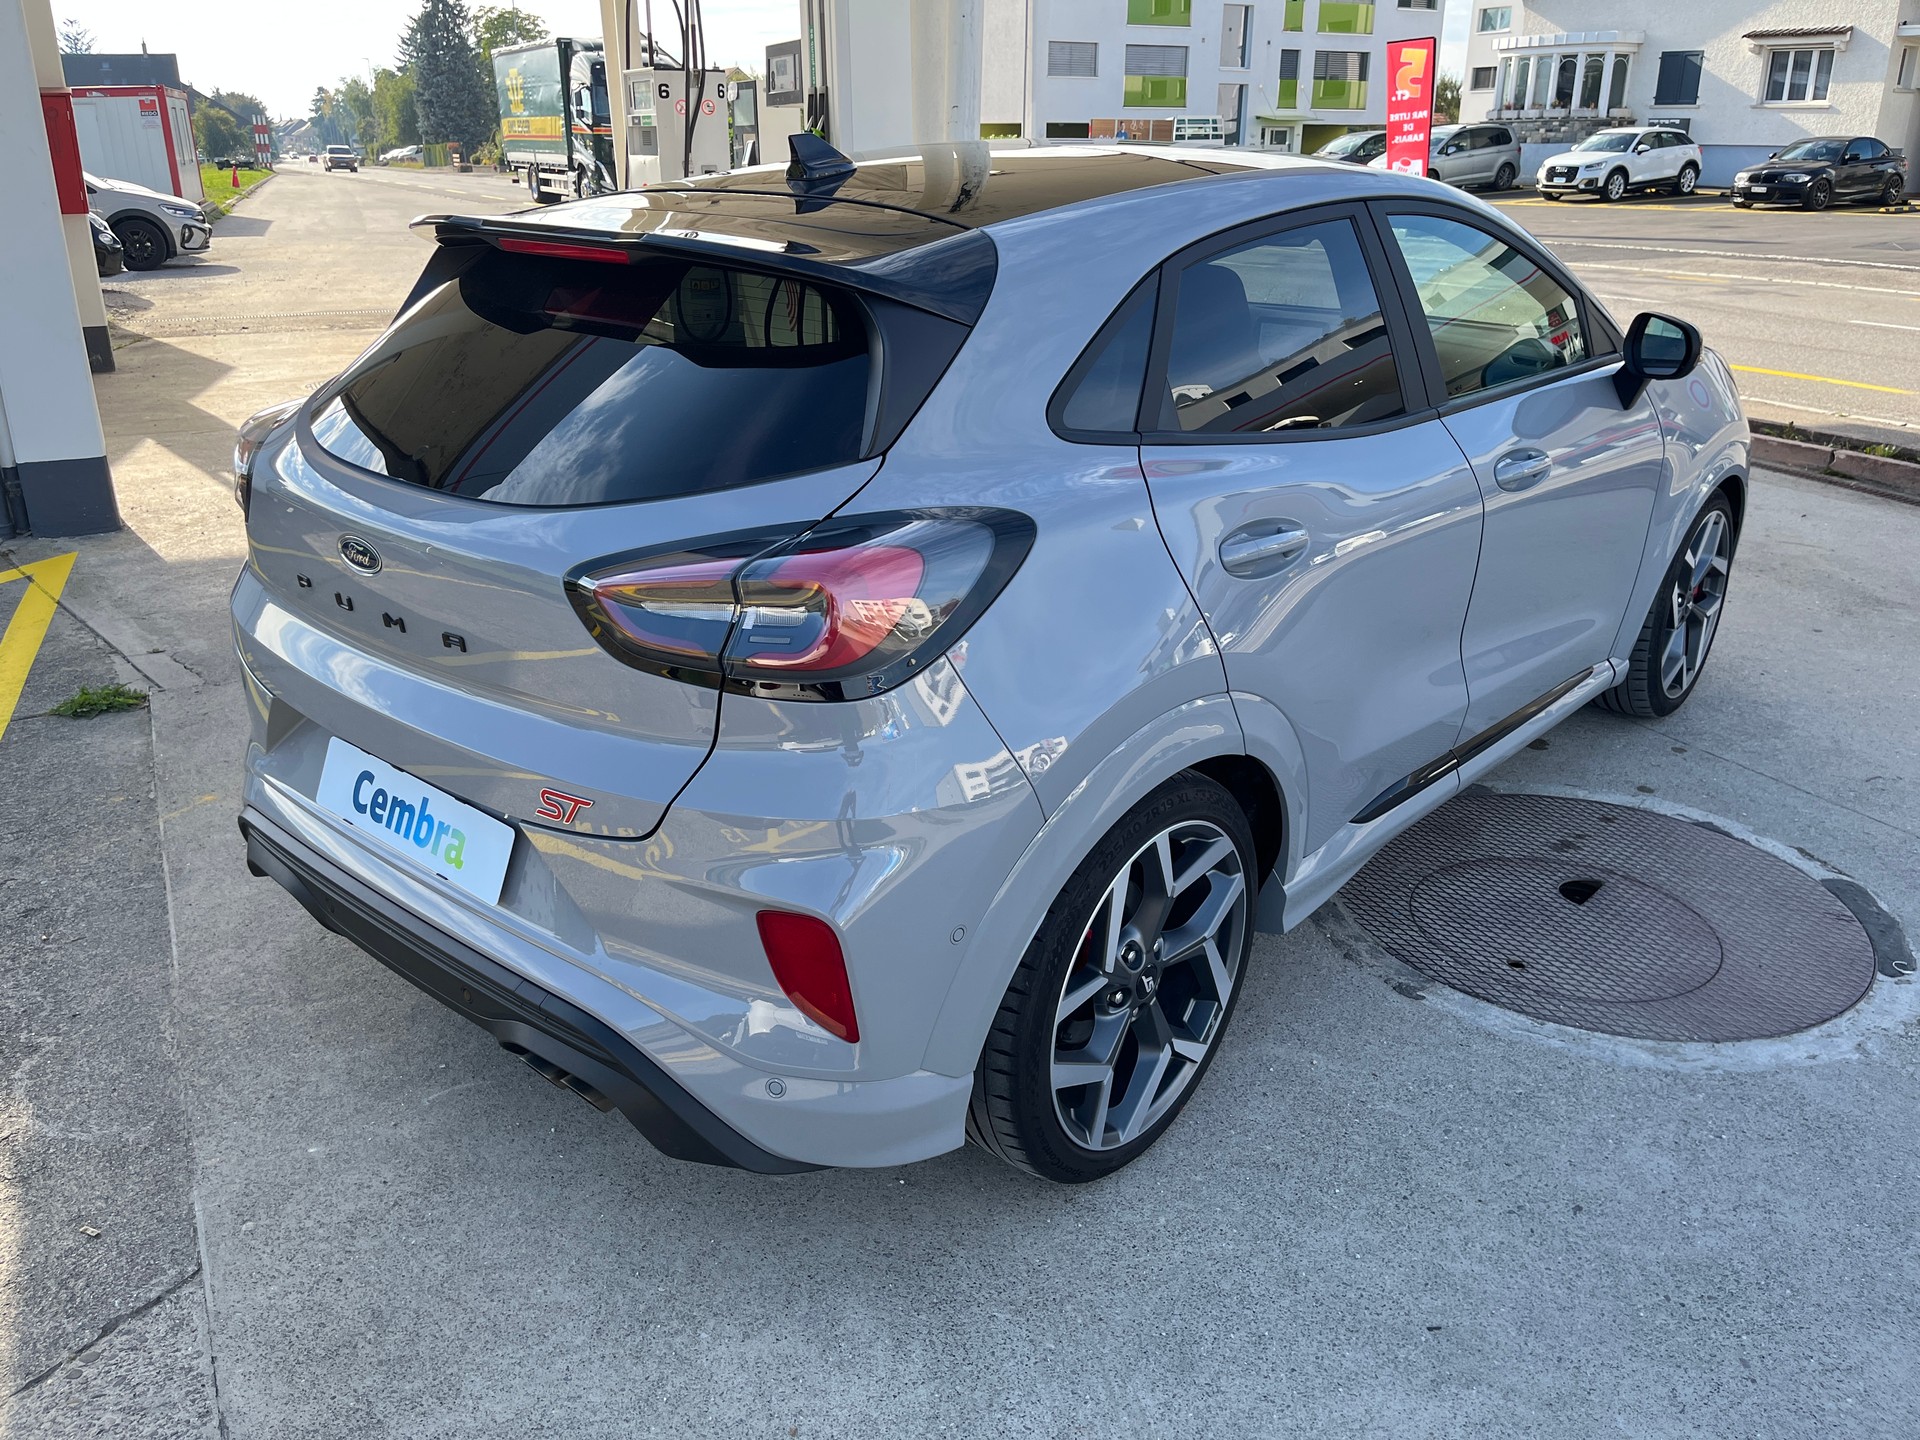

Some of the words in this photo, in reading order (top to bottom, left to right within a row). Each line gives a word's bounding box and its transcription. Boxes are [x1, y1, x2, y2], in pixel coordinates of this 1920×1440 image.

[658, 83, 670, 99] 6
[717, 83, 725, 99] 6
[346, 542, 372, 567] Ford
[297, 573, 467, 653] PUMA
[352, 769, 467, 870] Cembra
[535, 787, 594, 825] ST
